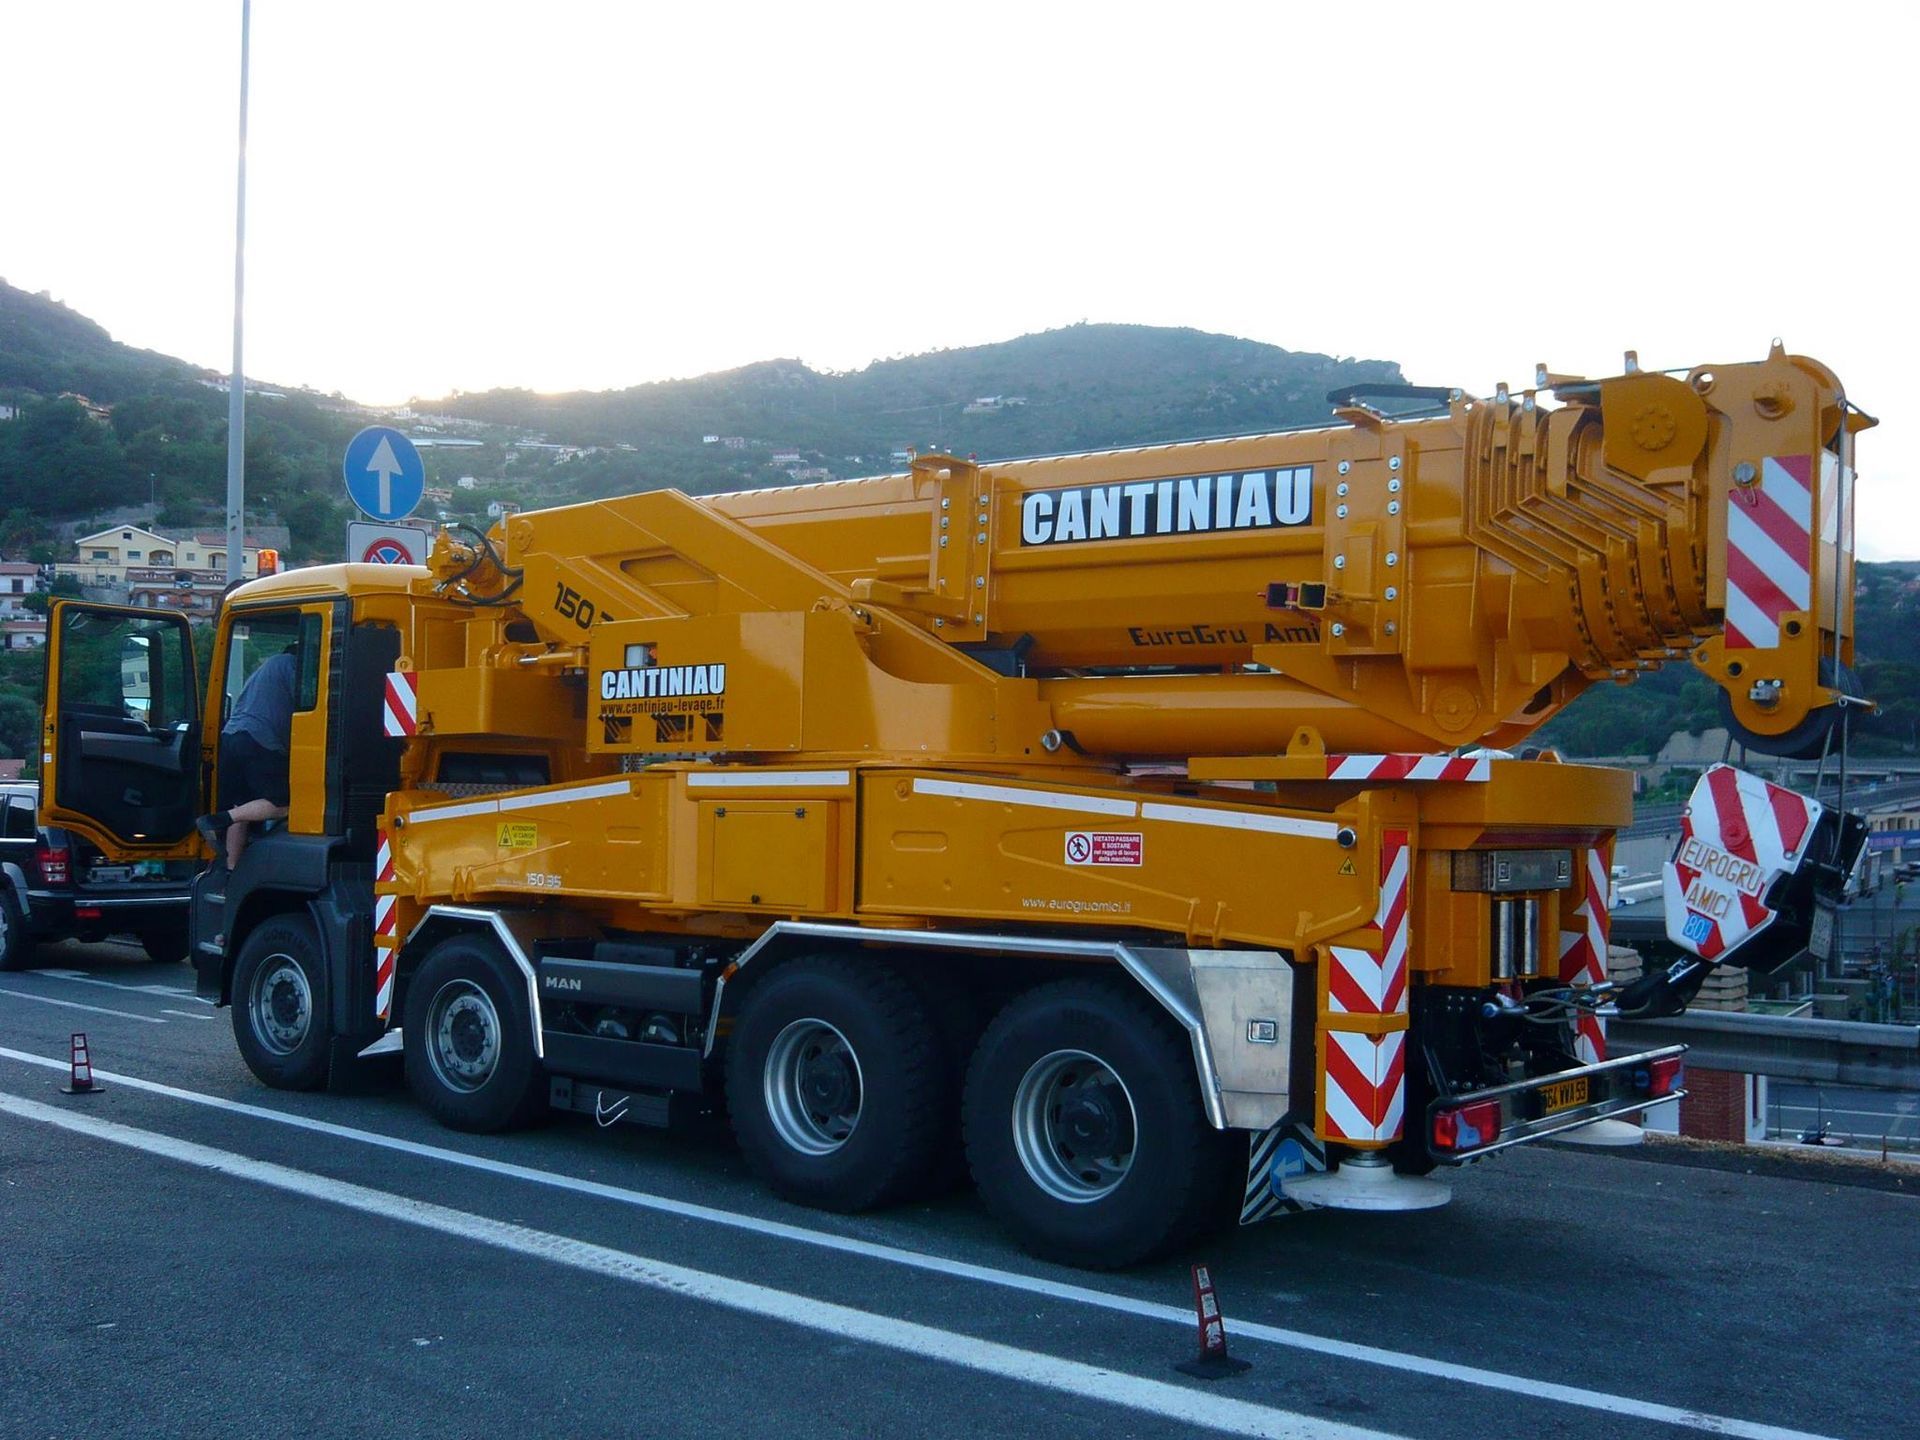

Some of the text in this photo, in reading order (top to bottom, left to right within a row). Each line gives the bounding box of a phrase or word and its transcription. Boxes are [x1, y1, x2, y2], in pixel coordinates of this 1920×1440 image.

[1022, 467, 1313, 545] CANTINIAU
[554, 581, 615, 630] 150
[1128, 622, 1321, 647] EuroGru Ami
[602, 664, 725, 700] CANTINIAU
[601, 696, 725, 717] www.cantiniau-levage.fr
[1682, 841, 1762, 892] EUROGRU
[1022, 897, 1131, 913] www.eurogruamici.it
[1687, 883, 1731, 920] AMICI
[546, 976, 582, 991] MAN
